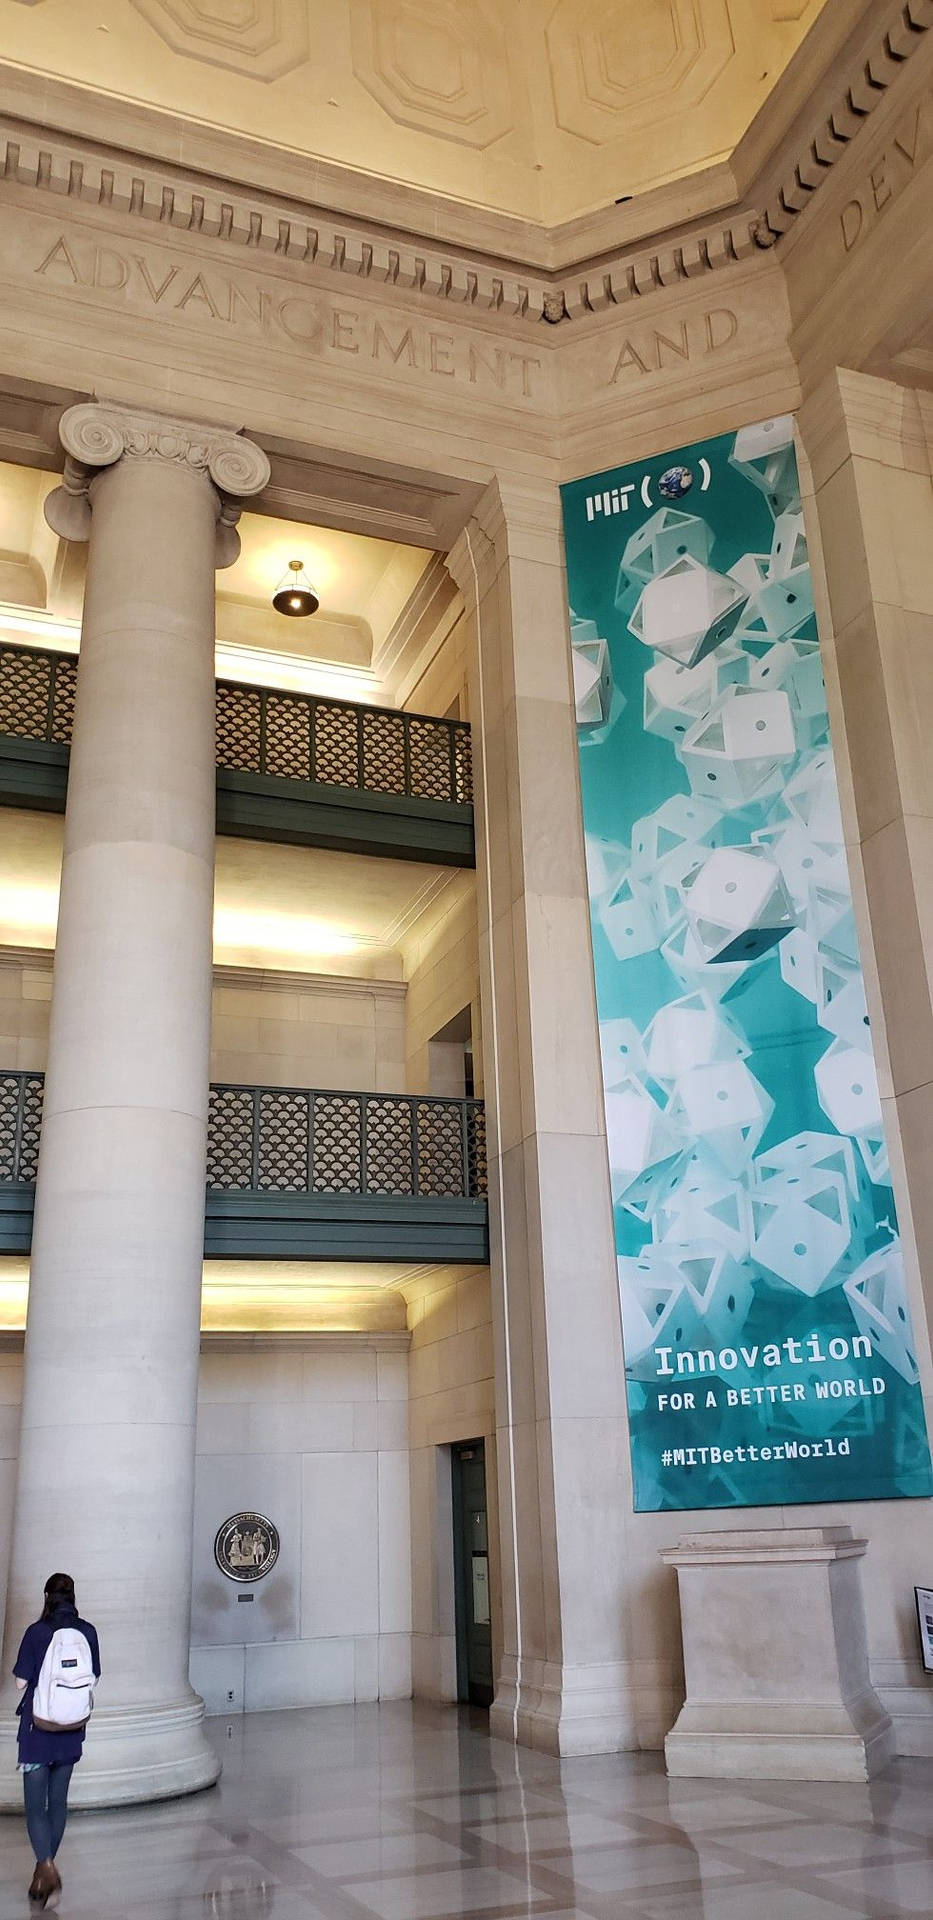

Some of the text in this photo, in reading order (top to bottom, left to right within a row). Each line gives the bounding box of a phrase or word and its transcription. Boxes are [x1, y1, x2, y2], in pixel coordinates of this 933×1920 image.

[35, 235, 738, 397] ADVANCEMENT AND
[654, 1333, 872, 1376] Innovation
[658, 1377, 886, 1412] FOR A BETTER WORLD
[661, 1438, 850, 1467] #MITBetterWorld
